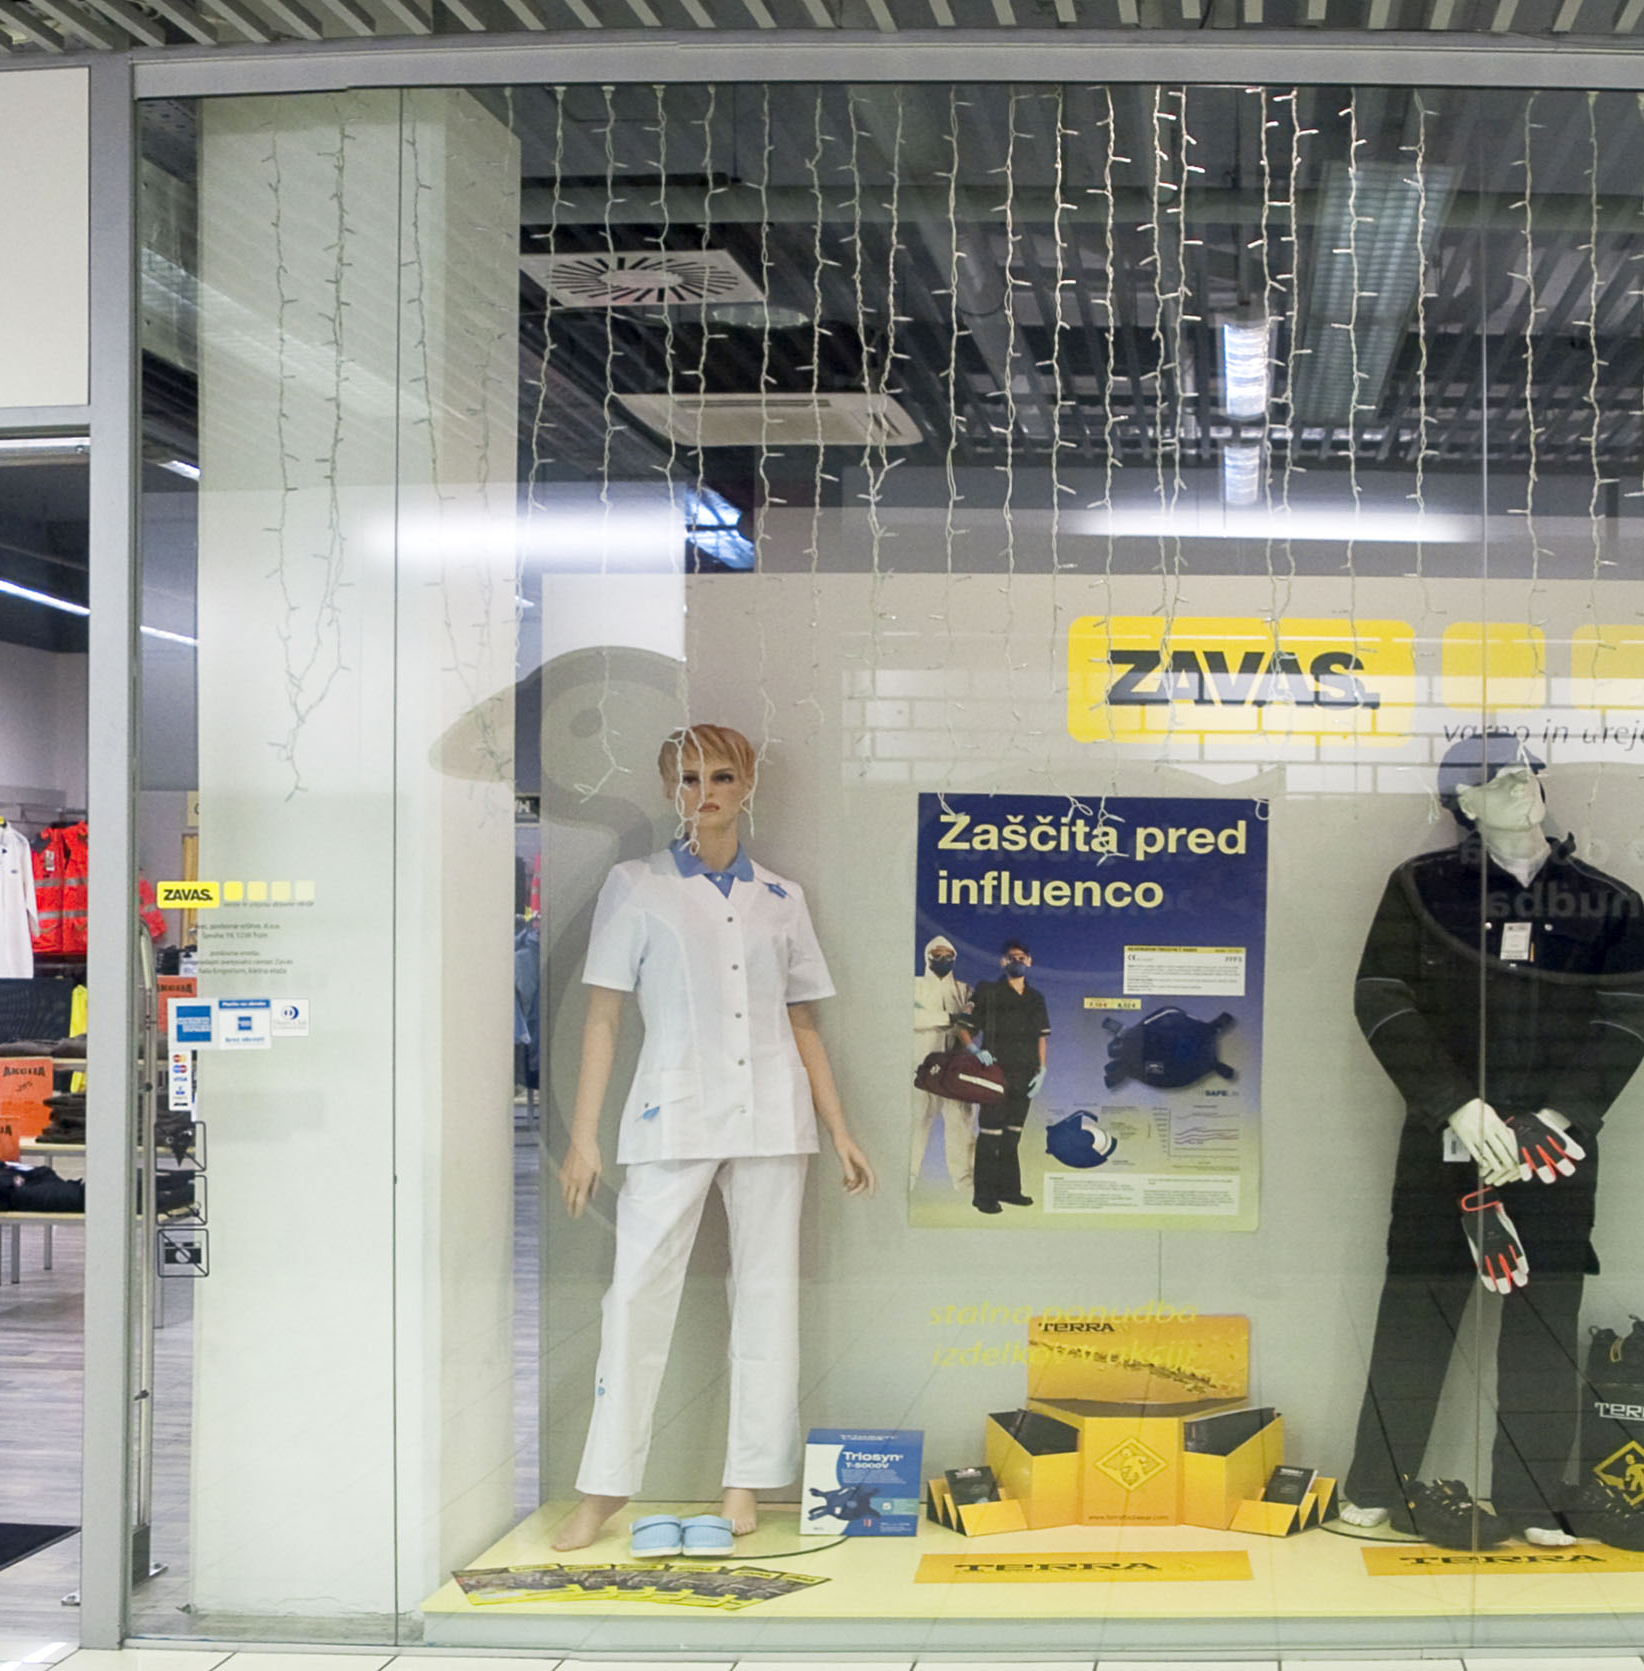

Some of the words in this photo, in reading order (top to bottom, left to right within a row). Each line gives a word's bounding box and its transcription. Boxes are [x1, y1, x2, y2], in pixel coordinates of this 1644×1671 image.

[1107, 649, 1380, 709] ZAVAS.
[1541, 719, 1569, 744] in
[938, 815, 1118, 853] Zaščita
[1136, 820, 1248, 861] pred
[164, 888, 213, 901] ZAVAS.
[938, 870, 1165, 909] influenco
[928, 1300, 1029, 1326] stalna
[1040, 1322, 1115, 1333] TERRA
[955, 1562, 1160, 1573] TERRA
